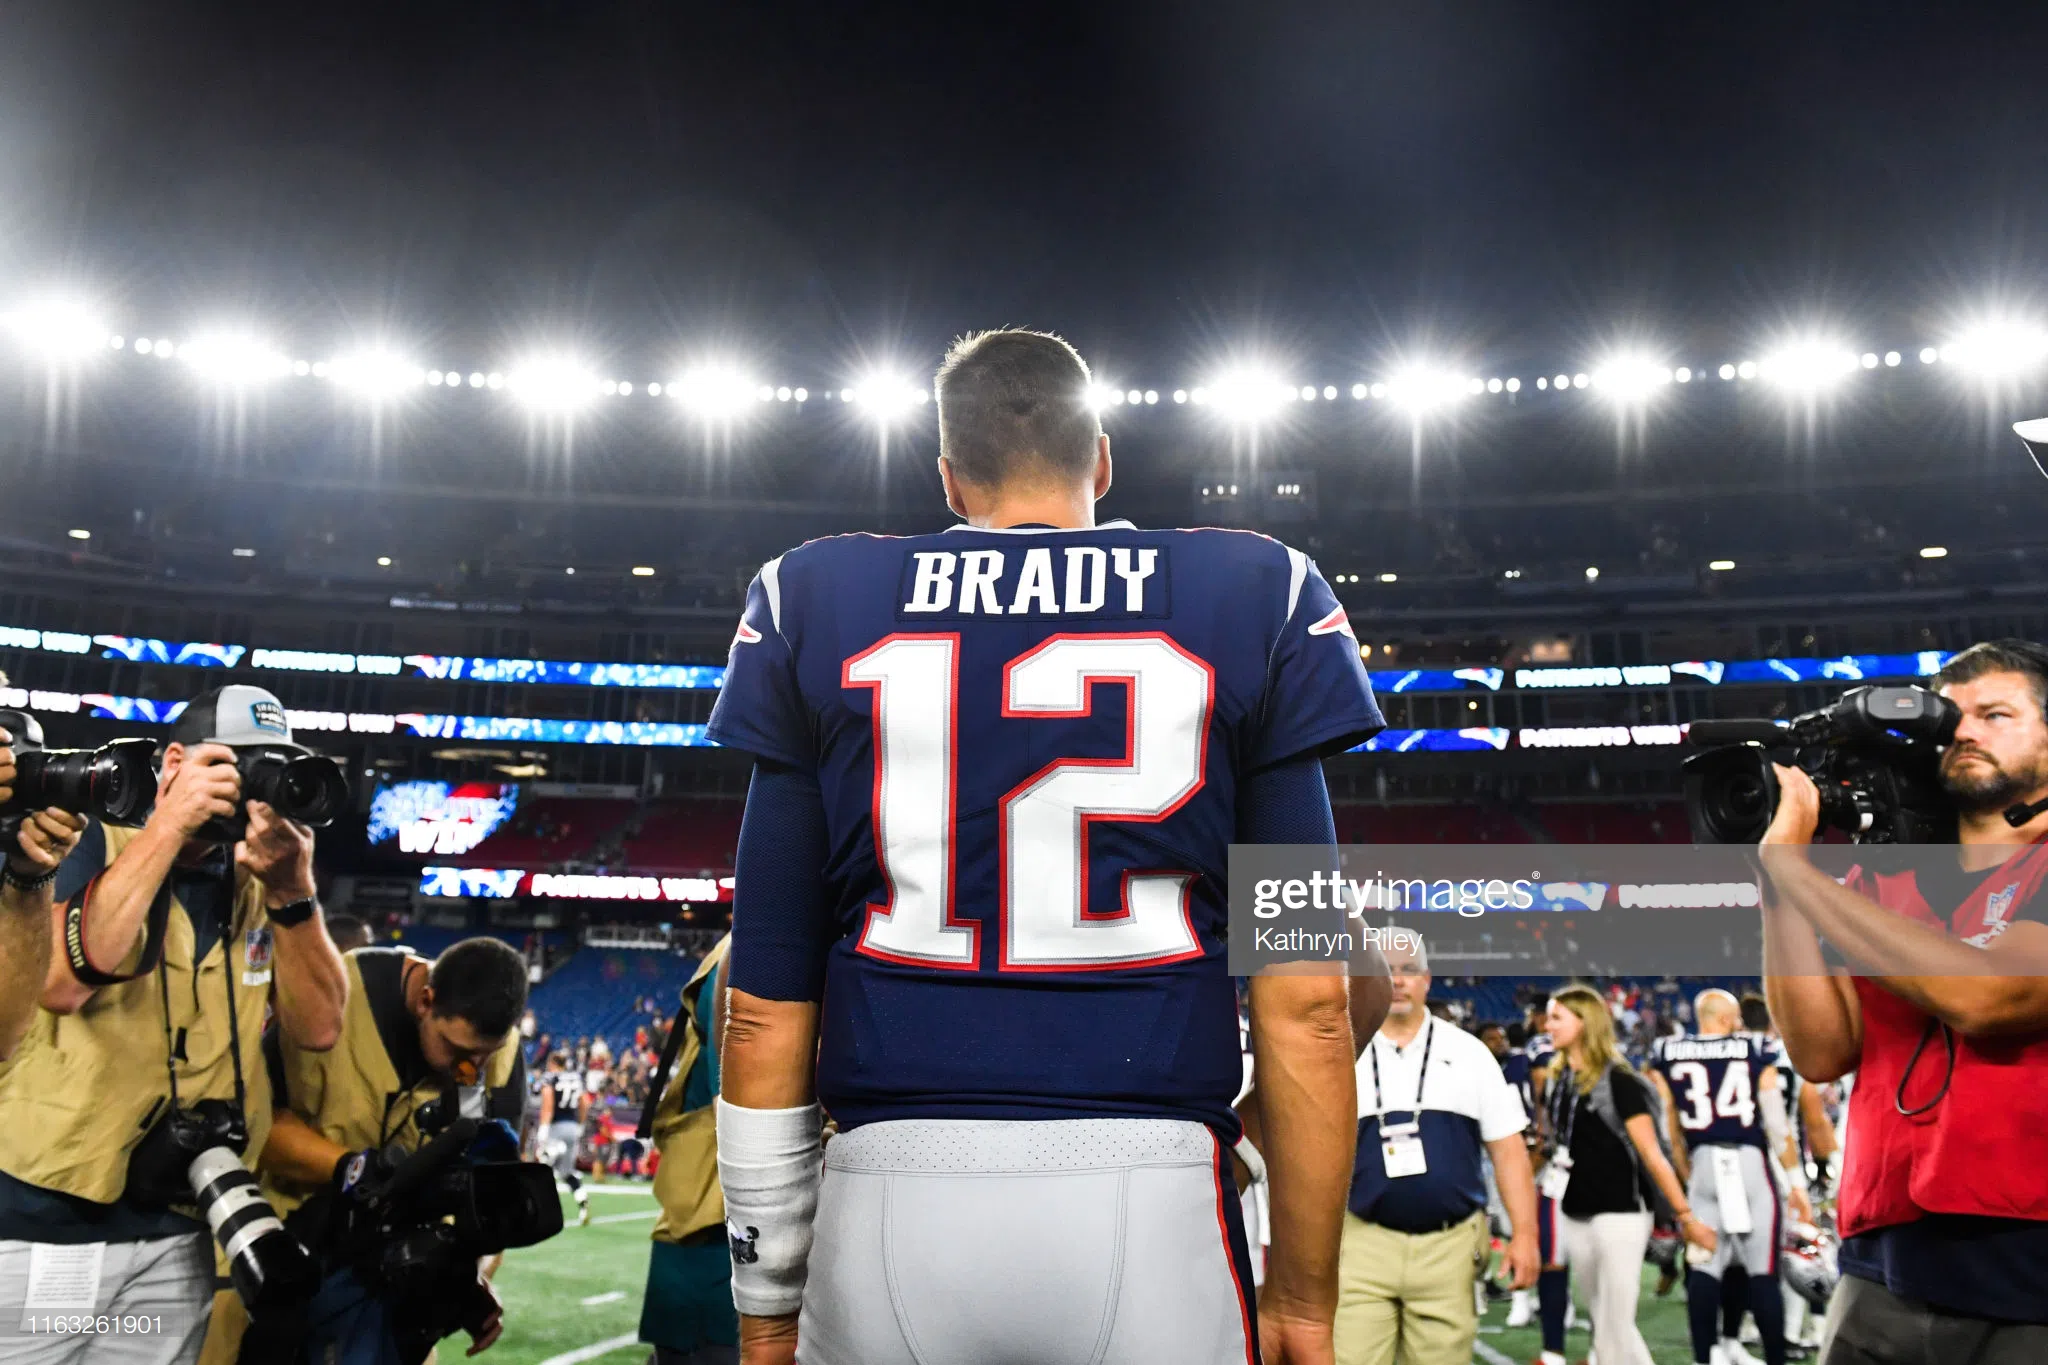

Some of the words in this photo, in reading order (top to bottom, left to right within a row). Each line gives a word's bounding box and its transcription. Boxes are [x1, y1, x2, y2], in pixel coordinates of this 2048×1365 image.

[903, 546, 1159, 614] BRADY
[841, 631, 1215, 972] 12
[67, 907, 85, 968] Canon
[1669, 1060, 1756, 1130] 34
